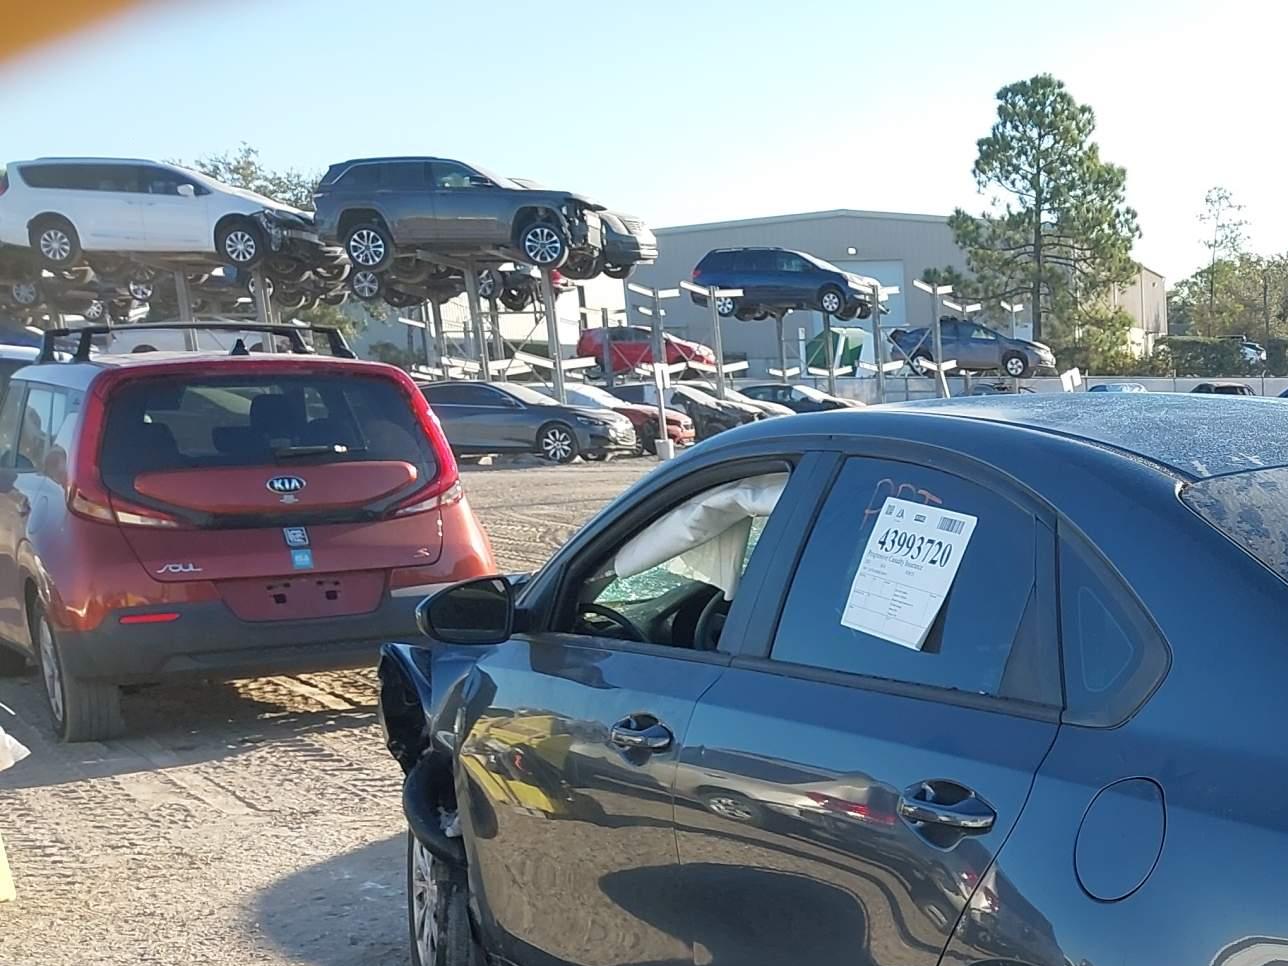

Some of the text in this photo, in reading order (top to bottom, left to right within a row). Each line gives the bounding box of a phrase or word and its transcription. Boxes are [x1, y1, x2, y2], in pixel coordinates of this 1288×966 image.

[272, 478, 300, 490] KIA
[878, 527, 953, 568] 43993720
[156, 562, 203, 574] SOUL
